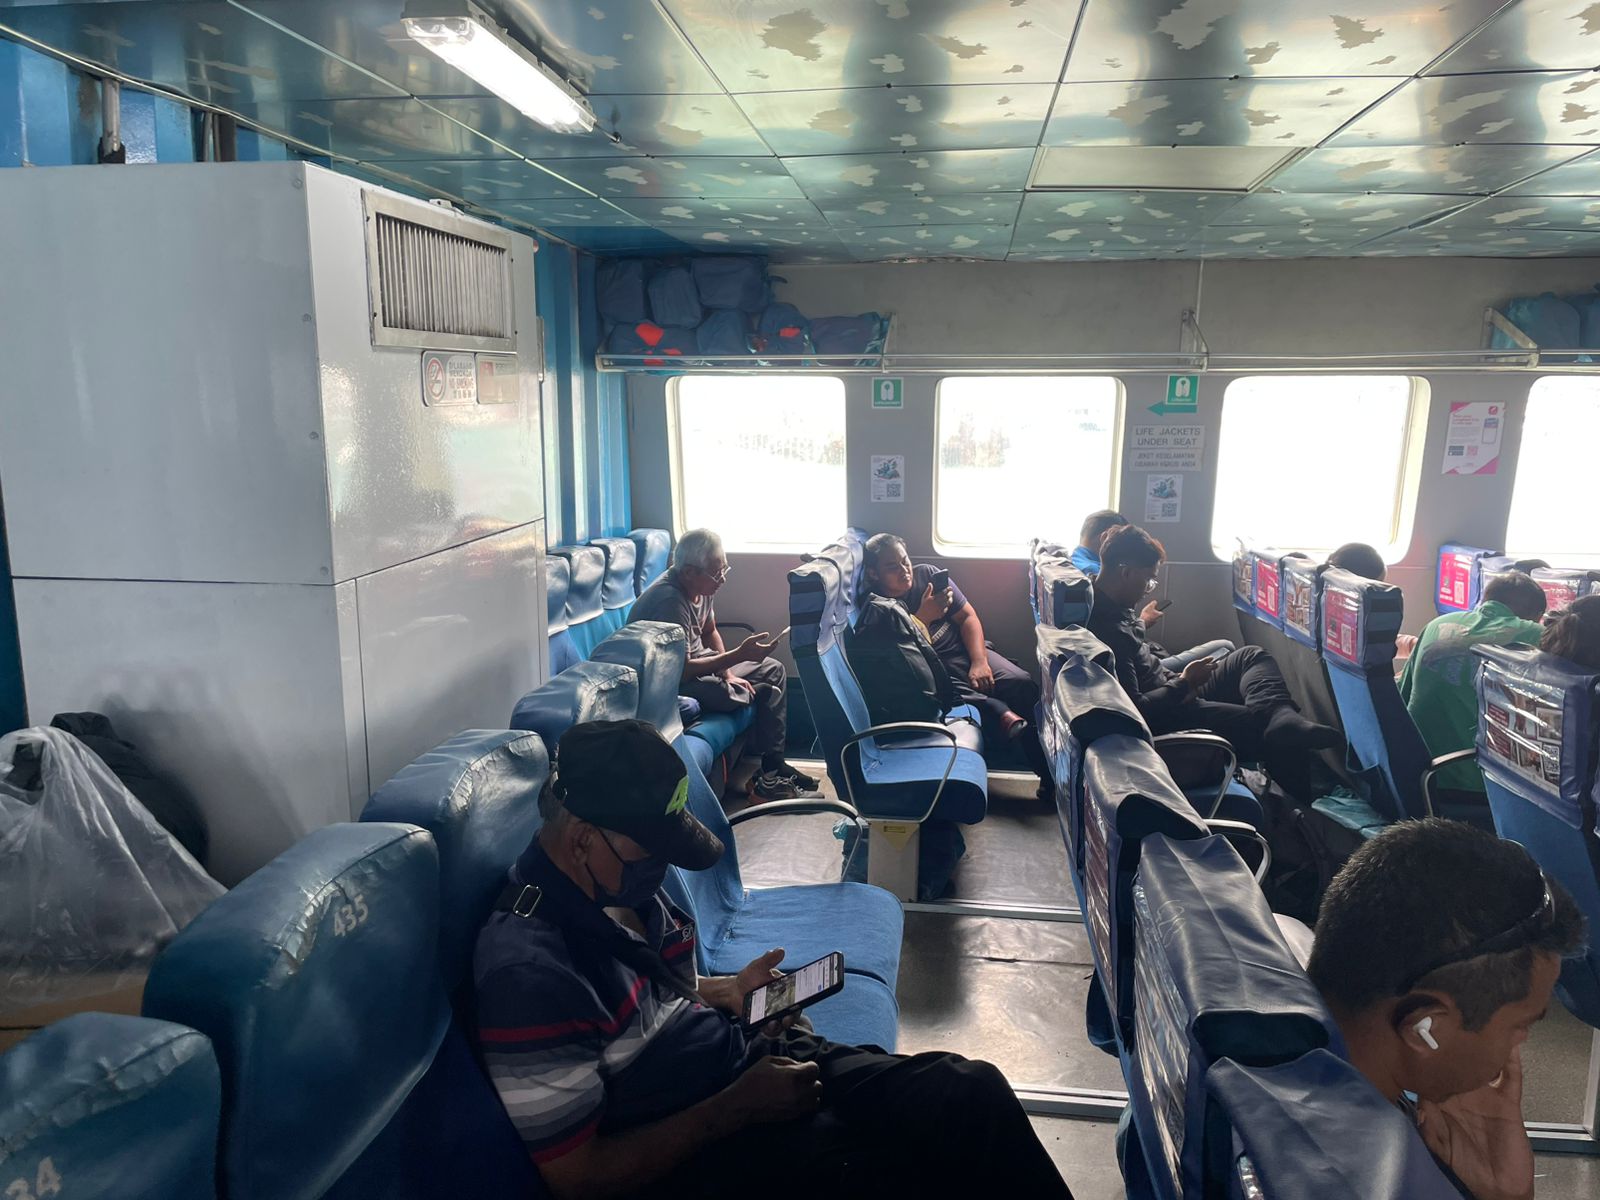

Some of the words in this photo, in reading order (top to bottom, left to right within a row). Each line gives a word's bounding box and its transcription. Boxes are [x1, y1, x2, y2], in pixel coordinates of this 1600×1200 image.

[1135, 427, 1154, 436] LIFE
[1159, 427, 1201, 436] JACKETS
[1137, 437, 1168, 446] UNDER
[1173, 437, 1198, 446] SEAT
[334, 893, 368, 937] 435
